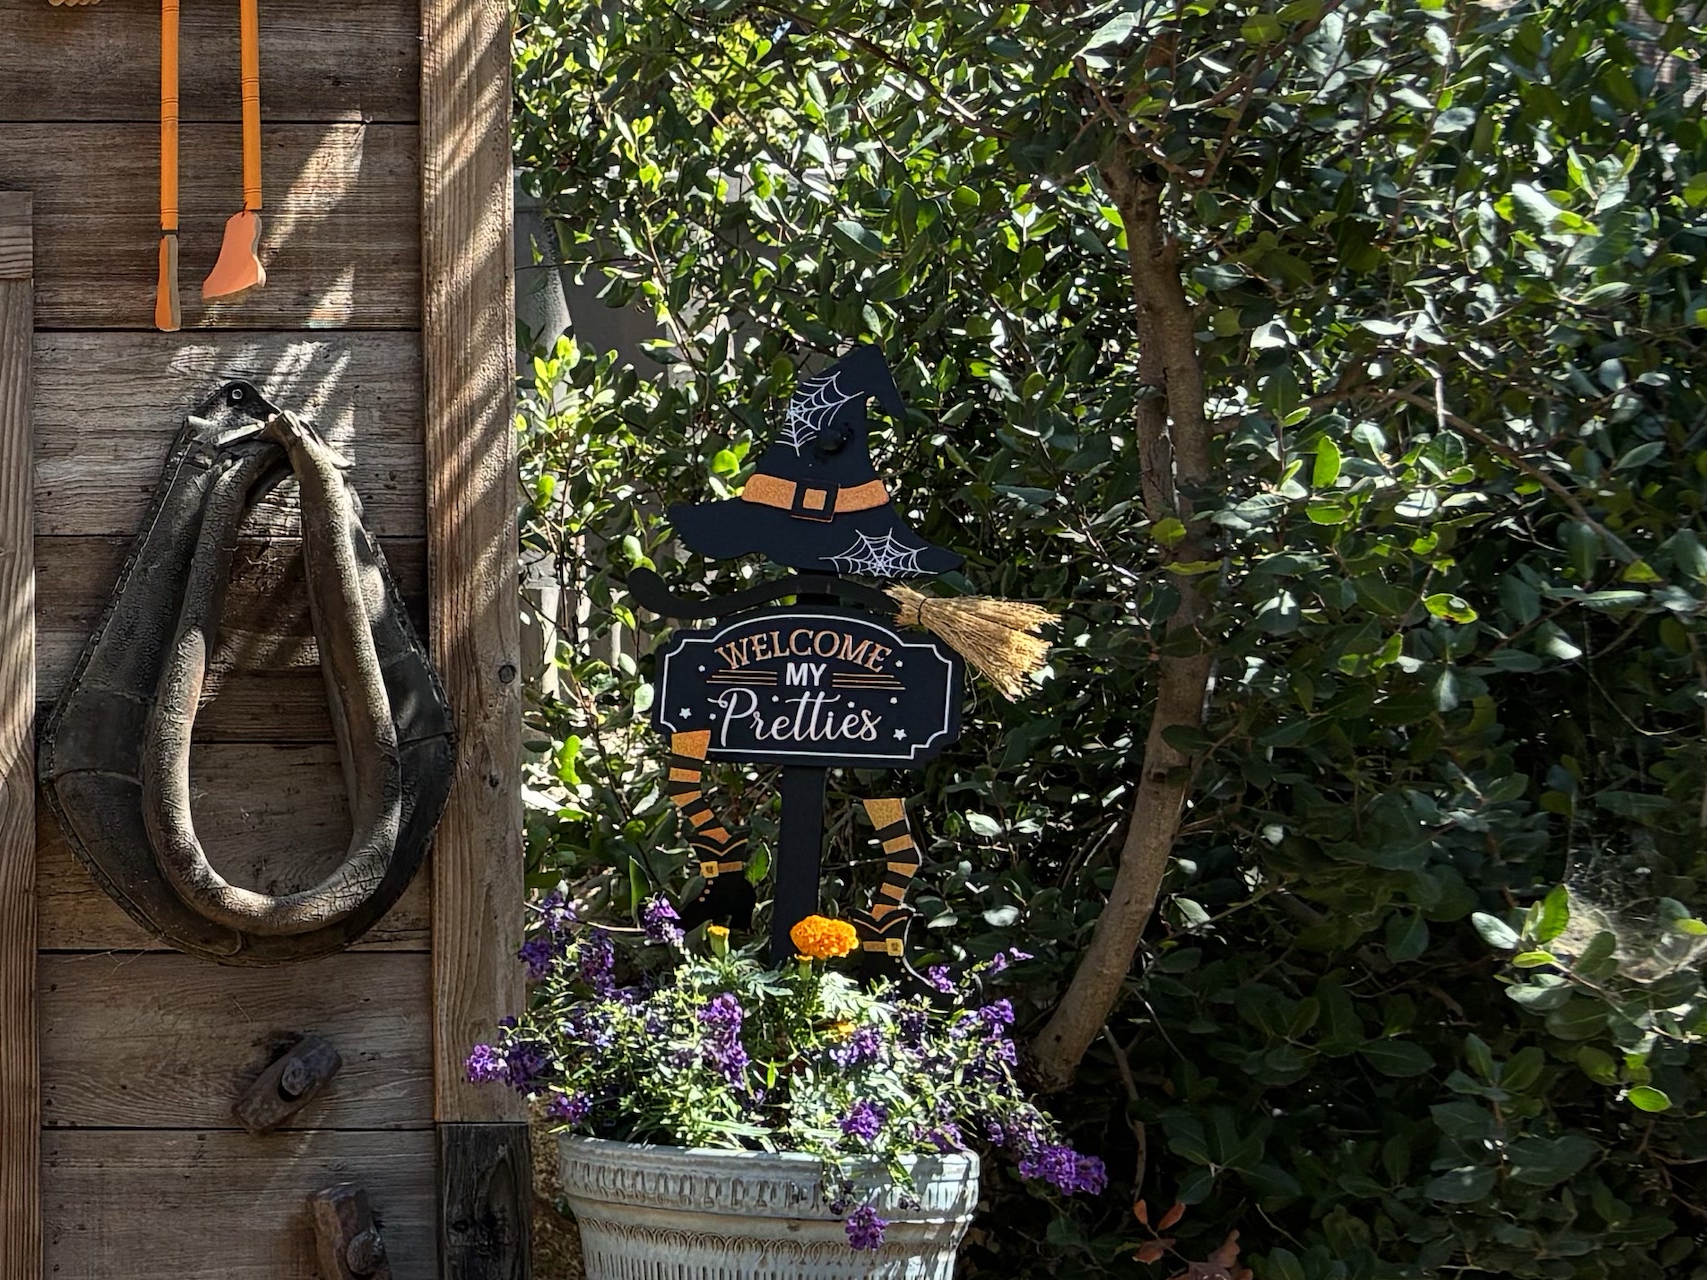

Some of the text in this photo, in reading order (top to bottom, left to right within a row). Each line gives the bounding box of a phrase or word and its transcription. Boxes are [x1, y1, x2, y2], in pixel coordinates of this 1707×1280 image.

[714, 628, 893, 673] WELCOME
[786, 662, 827, 687] MY
[707, 688, 882, 747] Pretties
